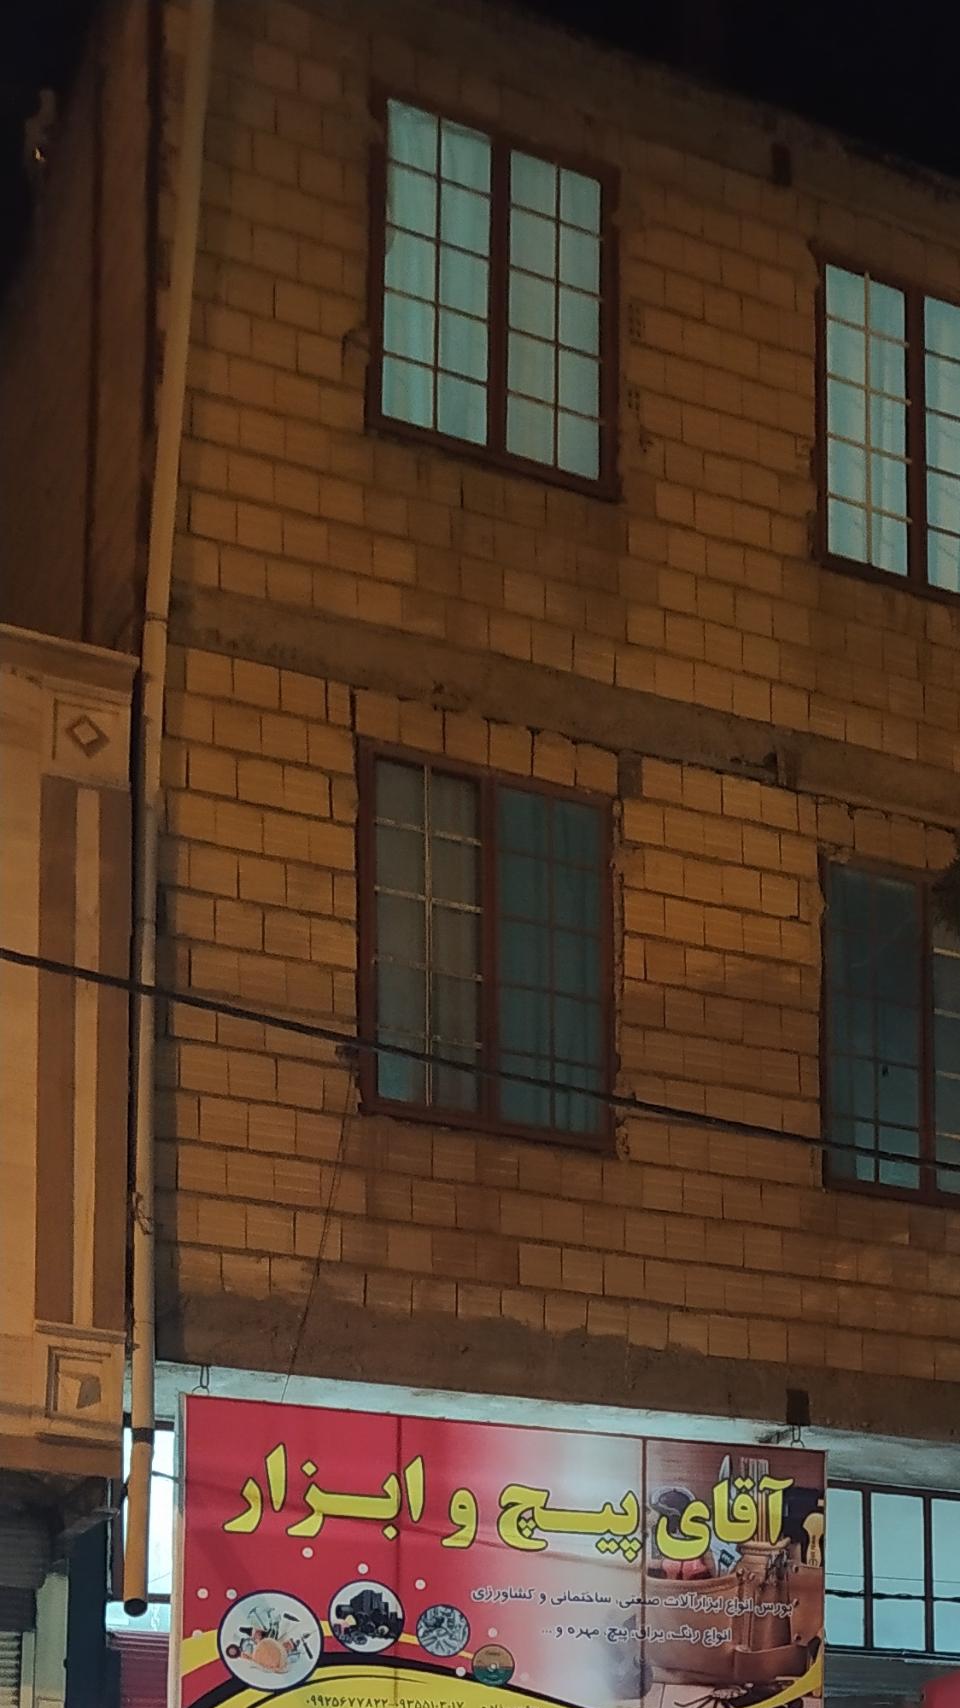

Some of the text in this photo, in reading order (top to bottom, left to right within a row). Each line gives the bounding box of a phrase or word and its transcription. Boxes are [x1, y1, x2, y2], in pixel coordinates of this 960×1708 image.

[222, 1443, 795, 1563] آقای پیچ و ابزار
[471, 1586, 535, 1603] کشاورزی
[539, 1592, 547, 1605] و
[550, 1589, 612, 1606] ساختمانی
[725, 1599, 753, 1617] انواع
[754, 1602, 794, 1619] بورس
[567, 1626, 600, 1641] مهره
[702, 1629, 732, 1647] انواع
